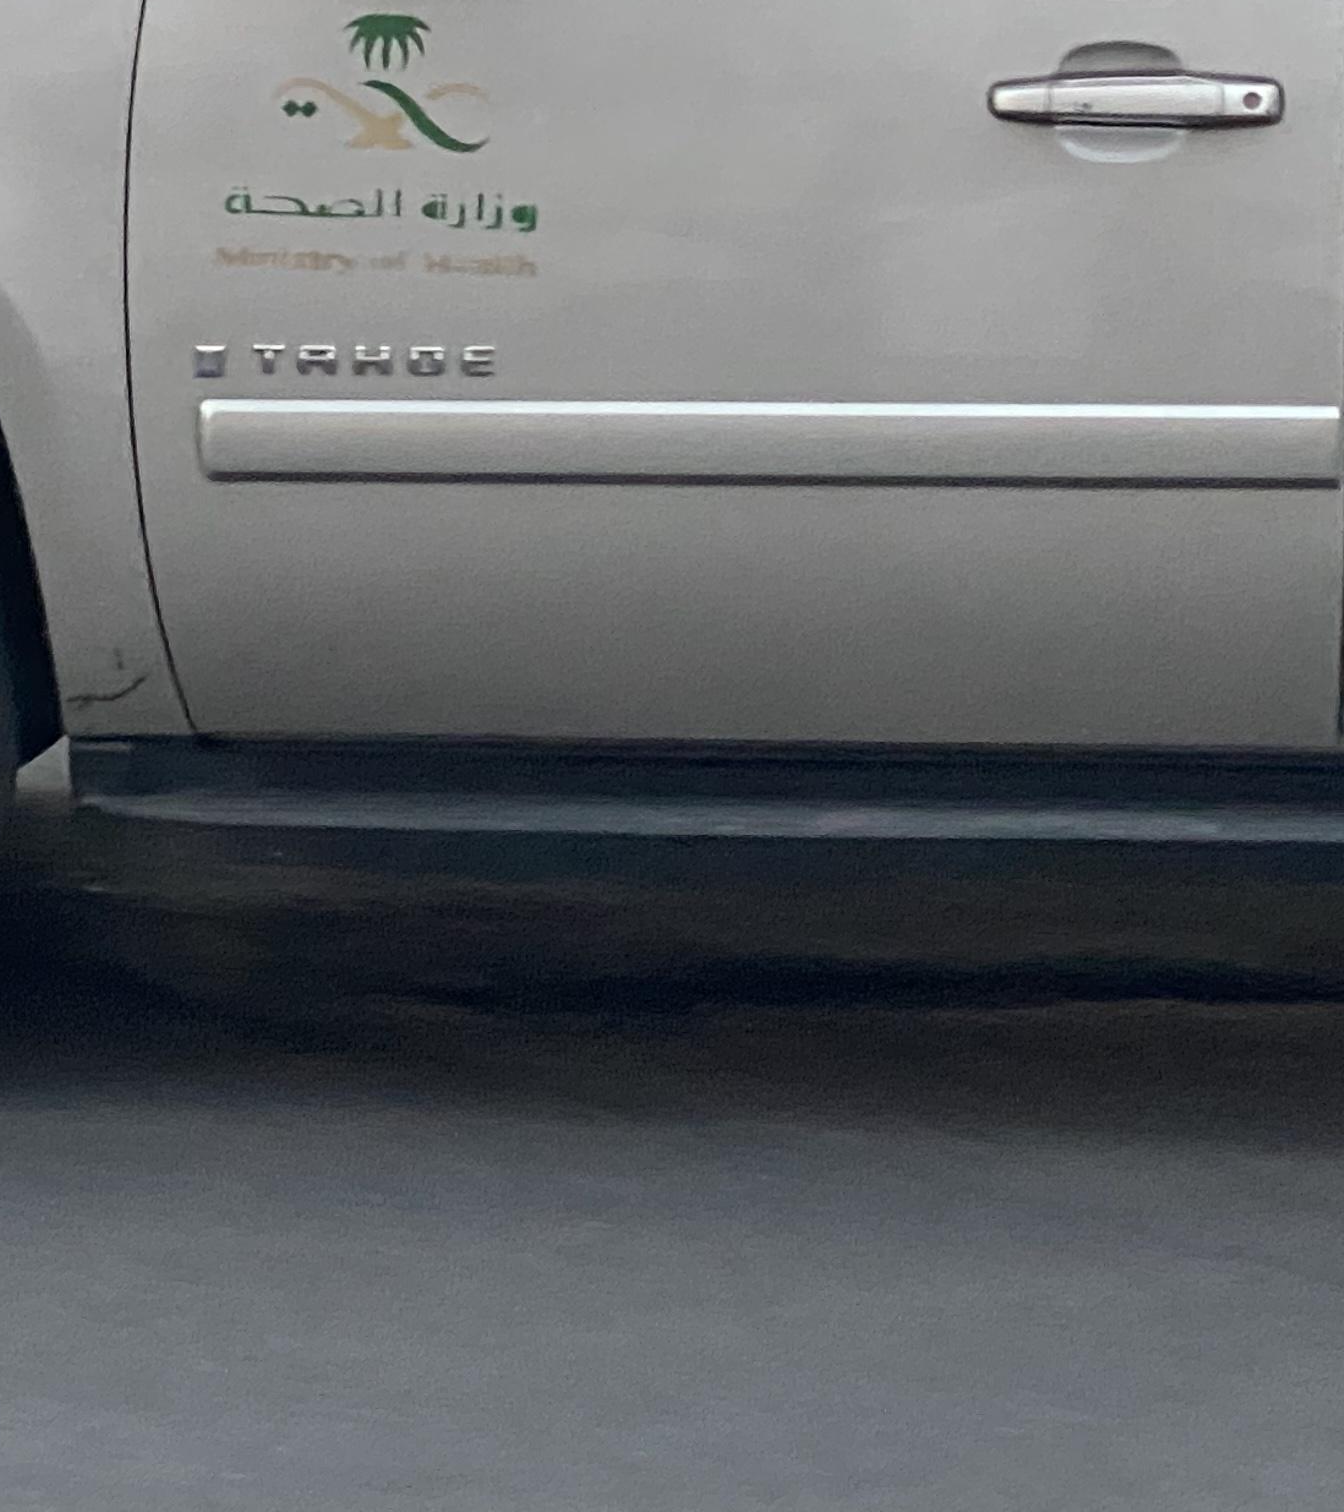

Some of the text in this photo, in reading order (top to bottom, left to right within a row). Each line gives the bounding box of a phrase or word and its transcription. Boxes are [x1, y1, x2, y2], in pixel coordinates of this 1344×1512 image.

[223, 185, 539, 233] وزارة الصحة
[252, 343, 497, 377] TAHOE
